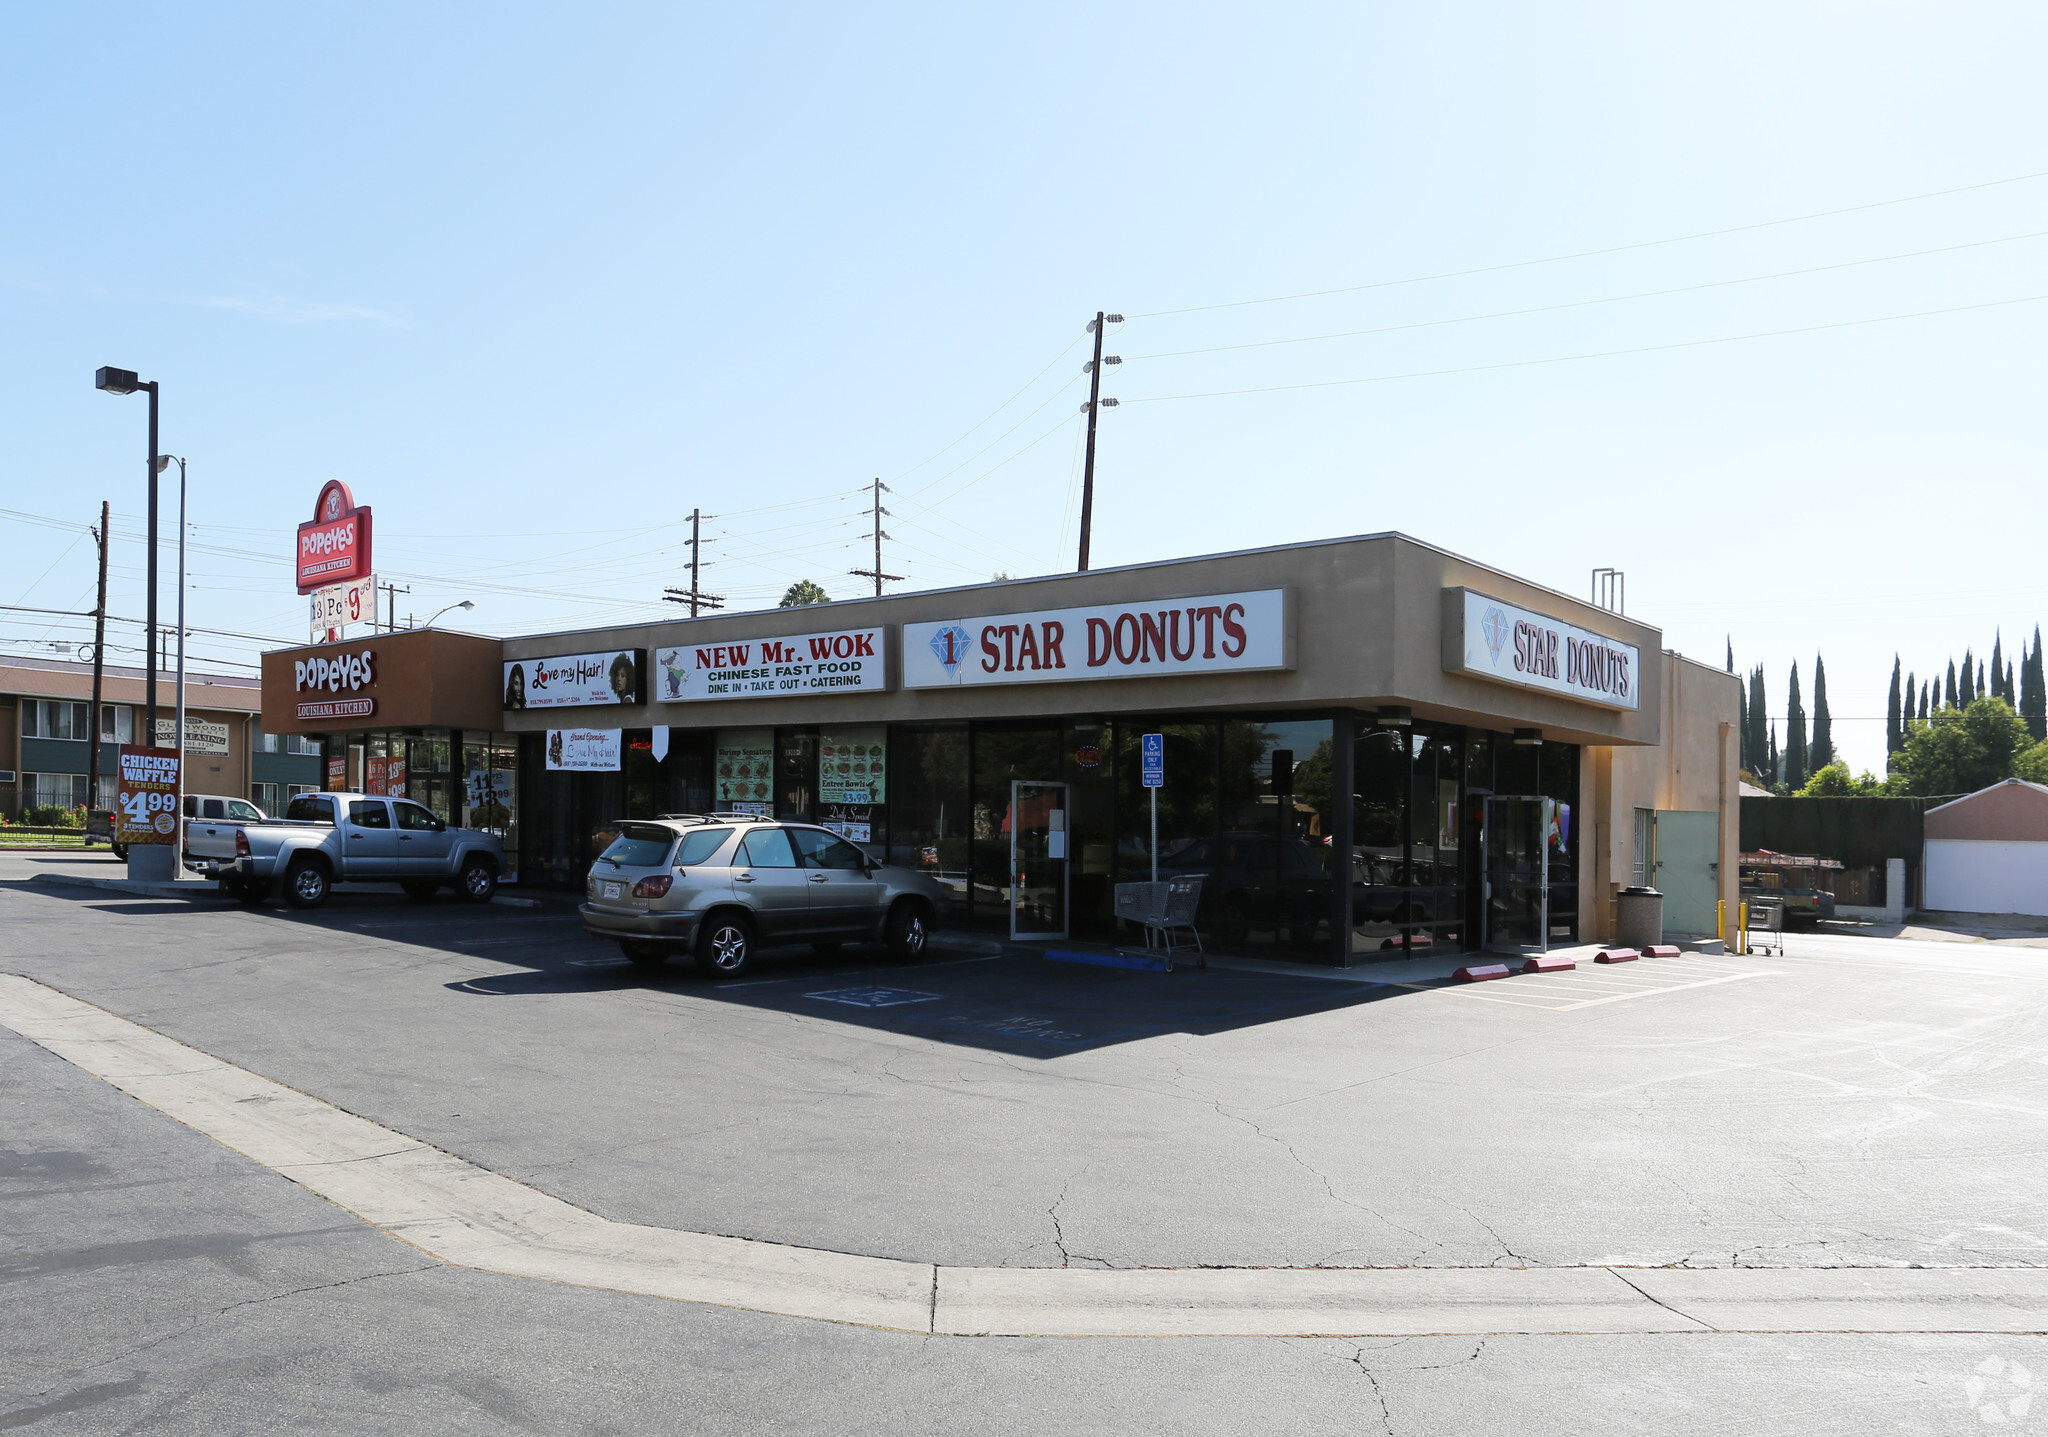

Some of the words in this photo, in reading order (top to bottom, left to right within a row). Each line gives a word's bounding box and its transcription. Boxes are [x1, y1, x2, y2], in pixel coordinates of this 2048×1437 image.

[302, 564, 326, 576] LOUISIANA
[327, 558, 351, 571] KITCHEN
[942, 630, 958, 665] 1
[980, 621, 1066, 674] STAR
[1086, 603, 1247, 668] DONUTS
[696, 644, 750, 670] NEW
[761, 642, 803, 664] Mr.
[808, 633, 875, 660] WOK
[1490, 613, 1500, 652] 1
[1514, 620, 1559, 680] STAR
[1567, 636, 1630, 697] DONUTS
[560, 667, 575, 684] my
[576, 660, 604, 685] Hair!
[708, 668, 770, 682] CHINESE
[776, 664, 812, 677] FAST
[818, 661, 862, 674] FOOD
[708, 684, 728, 694] DINE
[732, 683, 742, 692] IN
[750, 681, 774, 692] TAKE
[780, 679, 800, 690] OUT
[810, 675, 862, 688] CATERING
[298, 704, 333, 716] LOUISIANA
[335, 702, 369, 714] KITCHEN
[157, 721, 225, 732] GLNWOOD
[158, 727, 225, 736] APATMENTS
[184, 734, 224, 744] LEASING
[570, 732, 585, 742] Grand
[121, 754, 178, 771] CHICKEN
[368, 764, 376, 774] 16
[123, 768, 176, 784] WAFFLE
[128, 781, 170, 790] TENDERS
[843, 792, 867, 803] $3.99
[848, 805, 872, 822] Special
